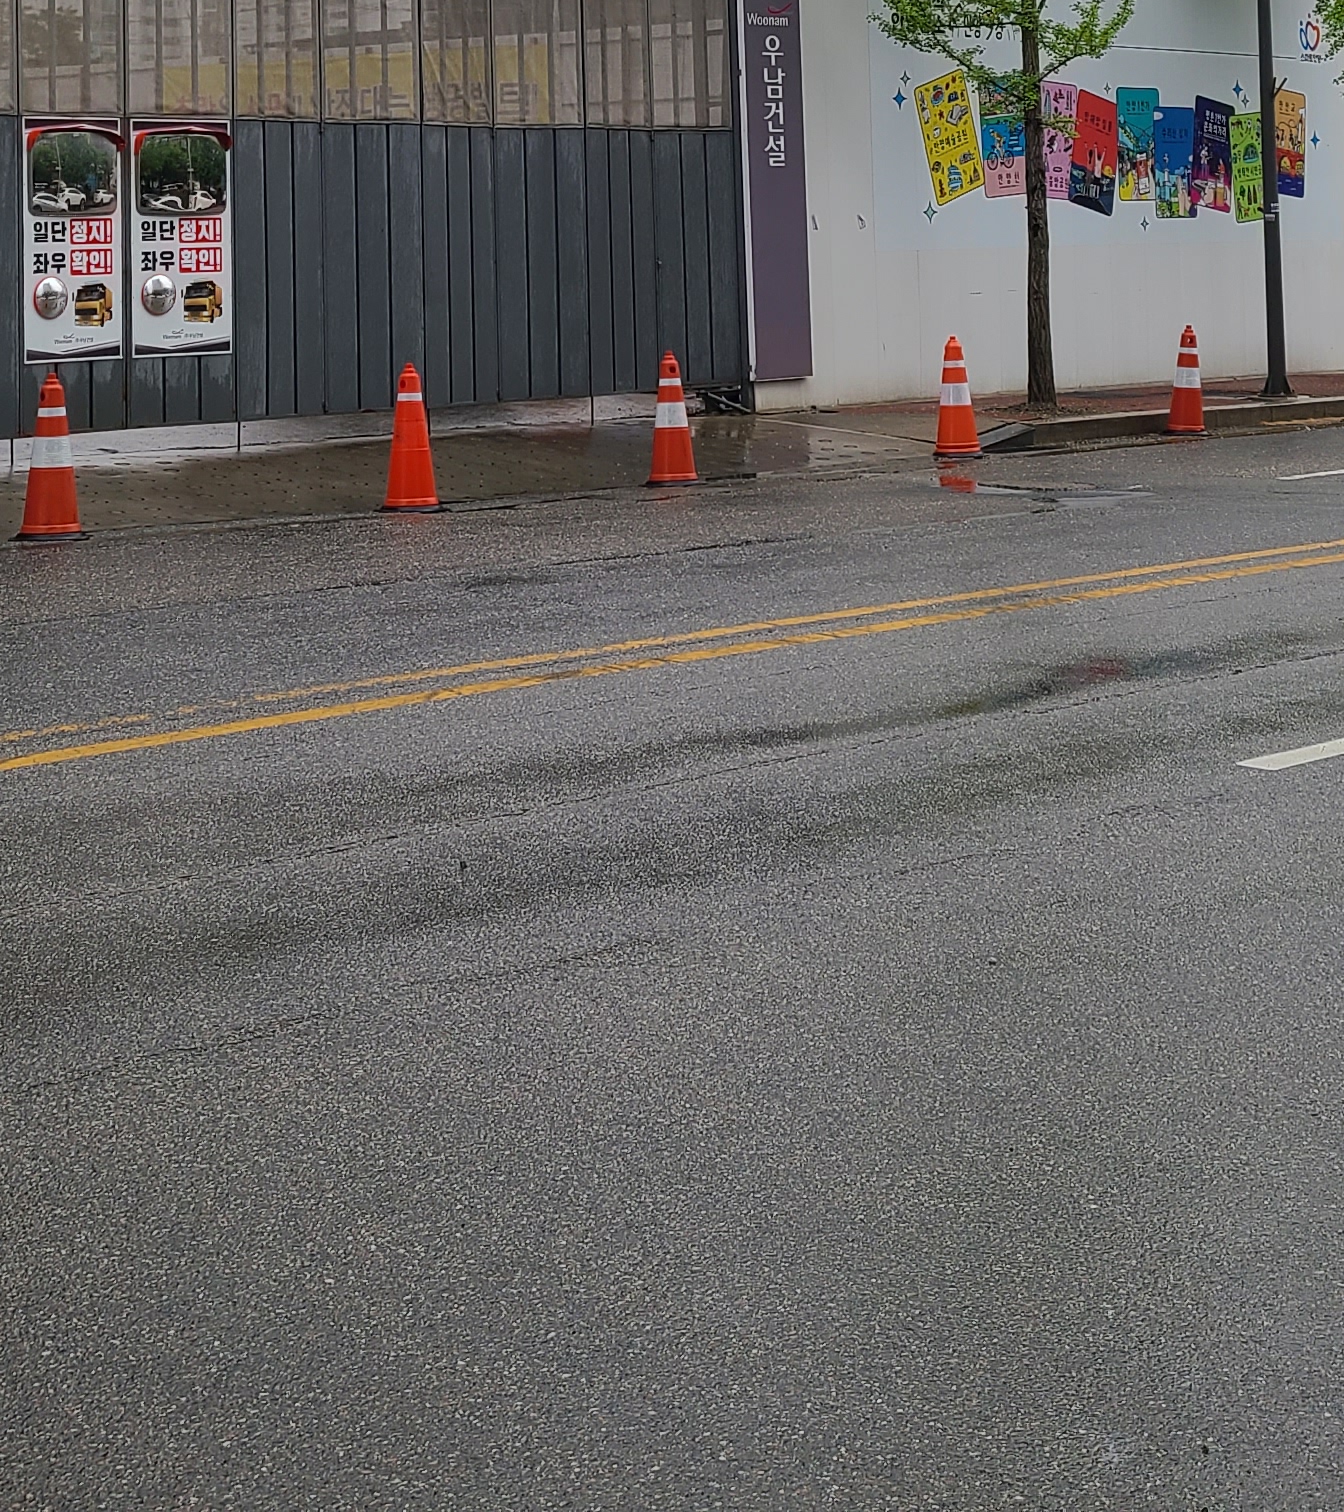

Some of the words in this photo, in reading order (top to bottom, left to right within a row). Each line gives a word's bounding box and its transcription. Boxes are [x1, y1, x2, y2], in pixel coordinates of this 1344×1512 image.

[747, 13, 789, 28] Woonam
[761, 35, 786, 167] 우남건설
[33, 221, 67, 243] 일단
[71, 220, 112, 243] 정지!
[141, 220, 175, 242] 일단
[179, 219, 221, 242] 정지!
[33, 252, 67, 275] 좌우
[71, 250, 112, 274] 확인!
[141, 251, 175, 272] 좌우
[179, 249, 221, 272] 확인!
